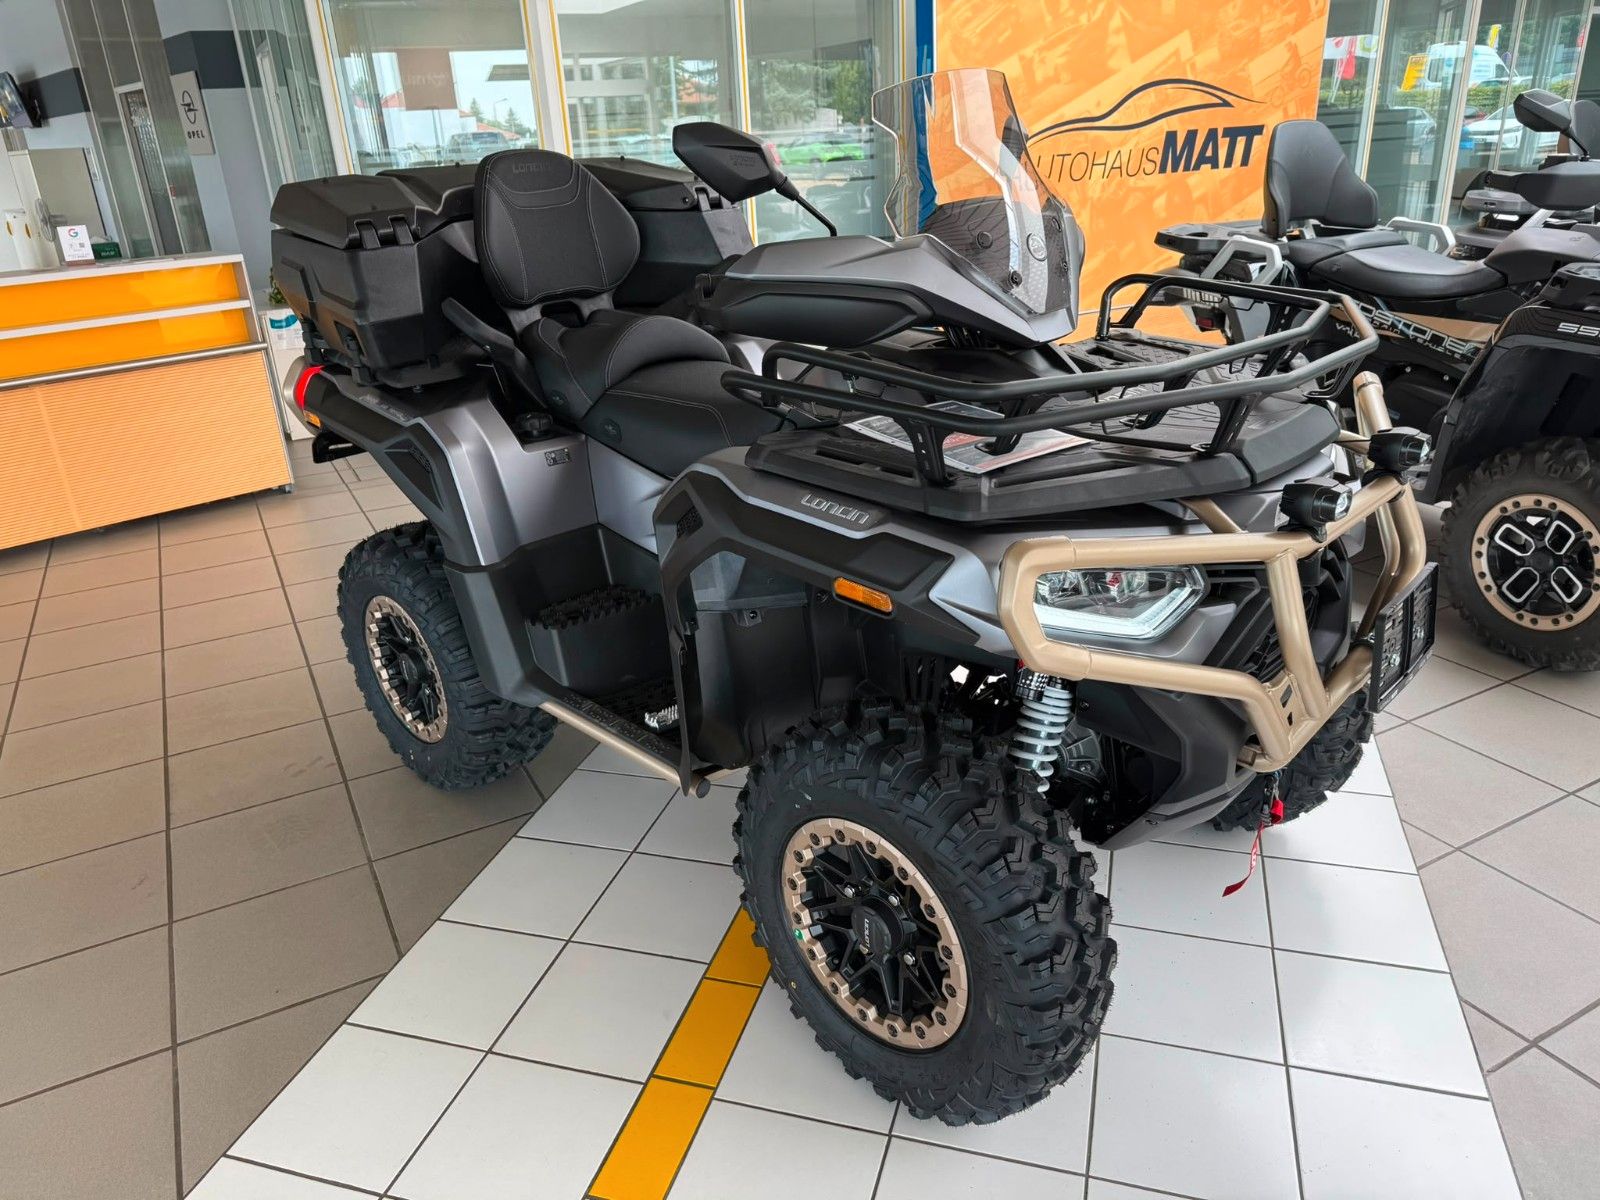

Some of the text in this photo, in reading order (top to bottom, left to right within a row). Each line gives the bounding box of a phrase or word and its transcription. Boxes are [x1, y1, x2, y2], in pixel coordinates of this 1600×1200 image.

[187, 130, 206, 139] OPEL
[1036, 146, 1159, 183] UTOHAUS
[68, 228, 79, 238] G
[800, 493, 870, 525] LONCIN
